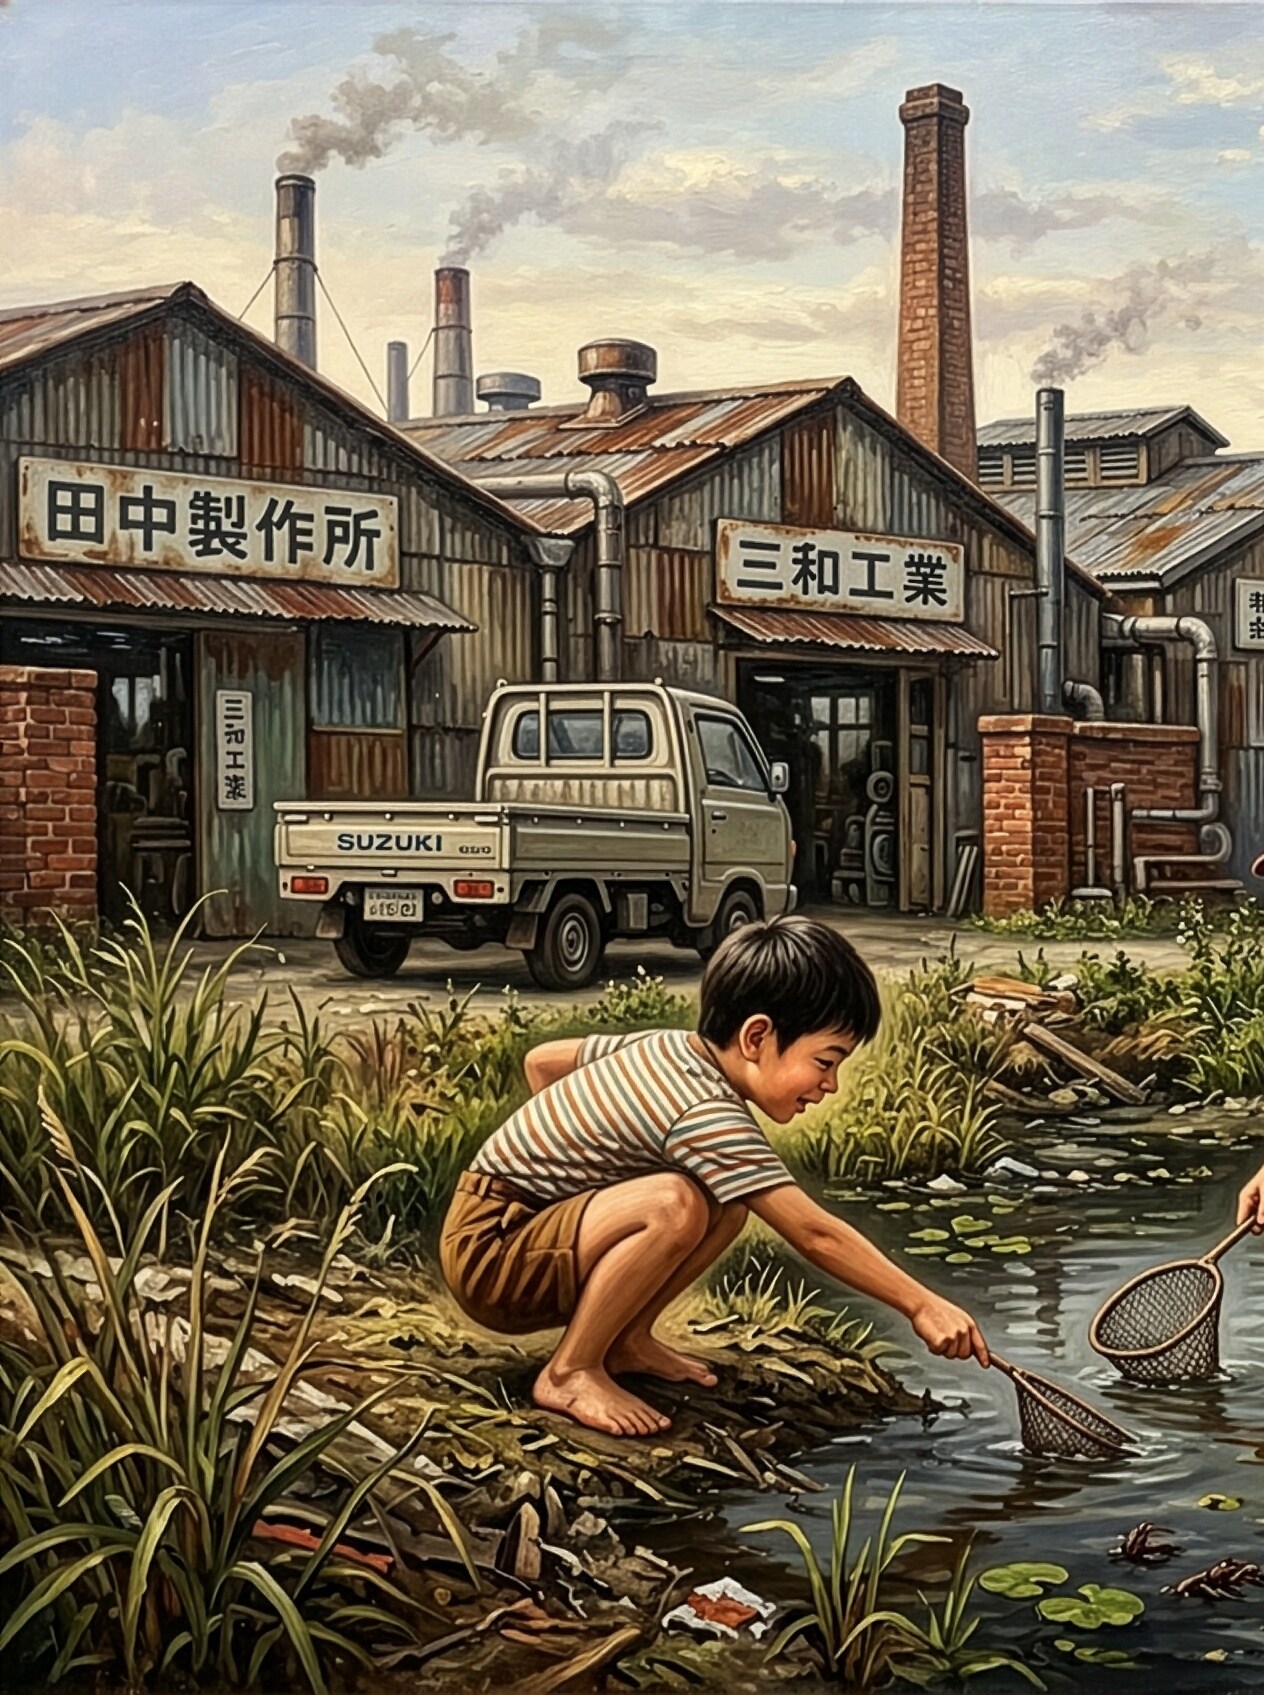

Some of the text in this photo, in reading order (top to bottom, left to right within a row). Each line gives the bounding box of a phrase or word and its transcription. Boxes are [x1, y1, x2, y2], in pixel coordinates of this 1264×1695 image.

[48, 480, 382, 571] 田中製作所
[736, 539, 948, 607] 三和工業
[337, 833, 443, 852] SUZUKI
